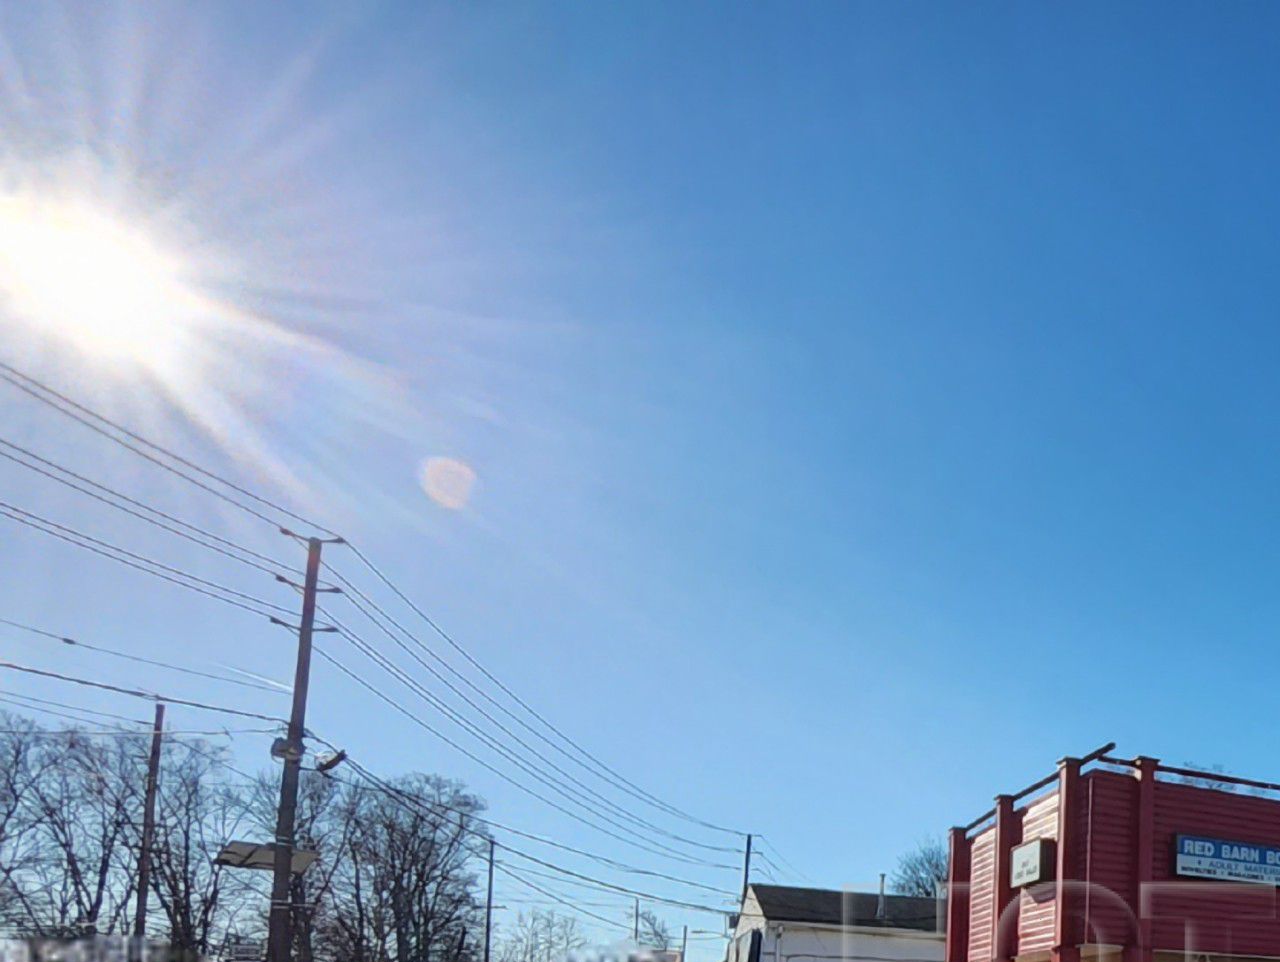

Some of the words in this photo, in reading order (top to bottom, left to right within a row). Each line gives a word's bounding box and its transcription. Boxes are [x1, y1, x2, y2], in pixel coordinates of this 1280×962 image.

[1184, 839, 1215, 857] RED
[1221, 844, 1259, 863] BARN
[1208, 858, 1239, 870] ADULT
